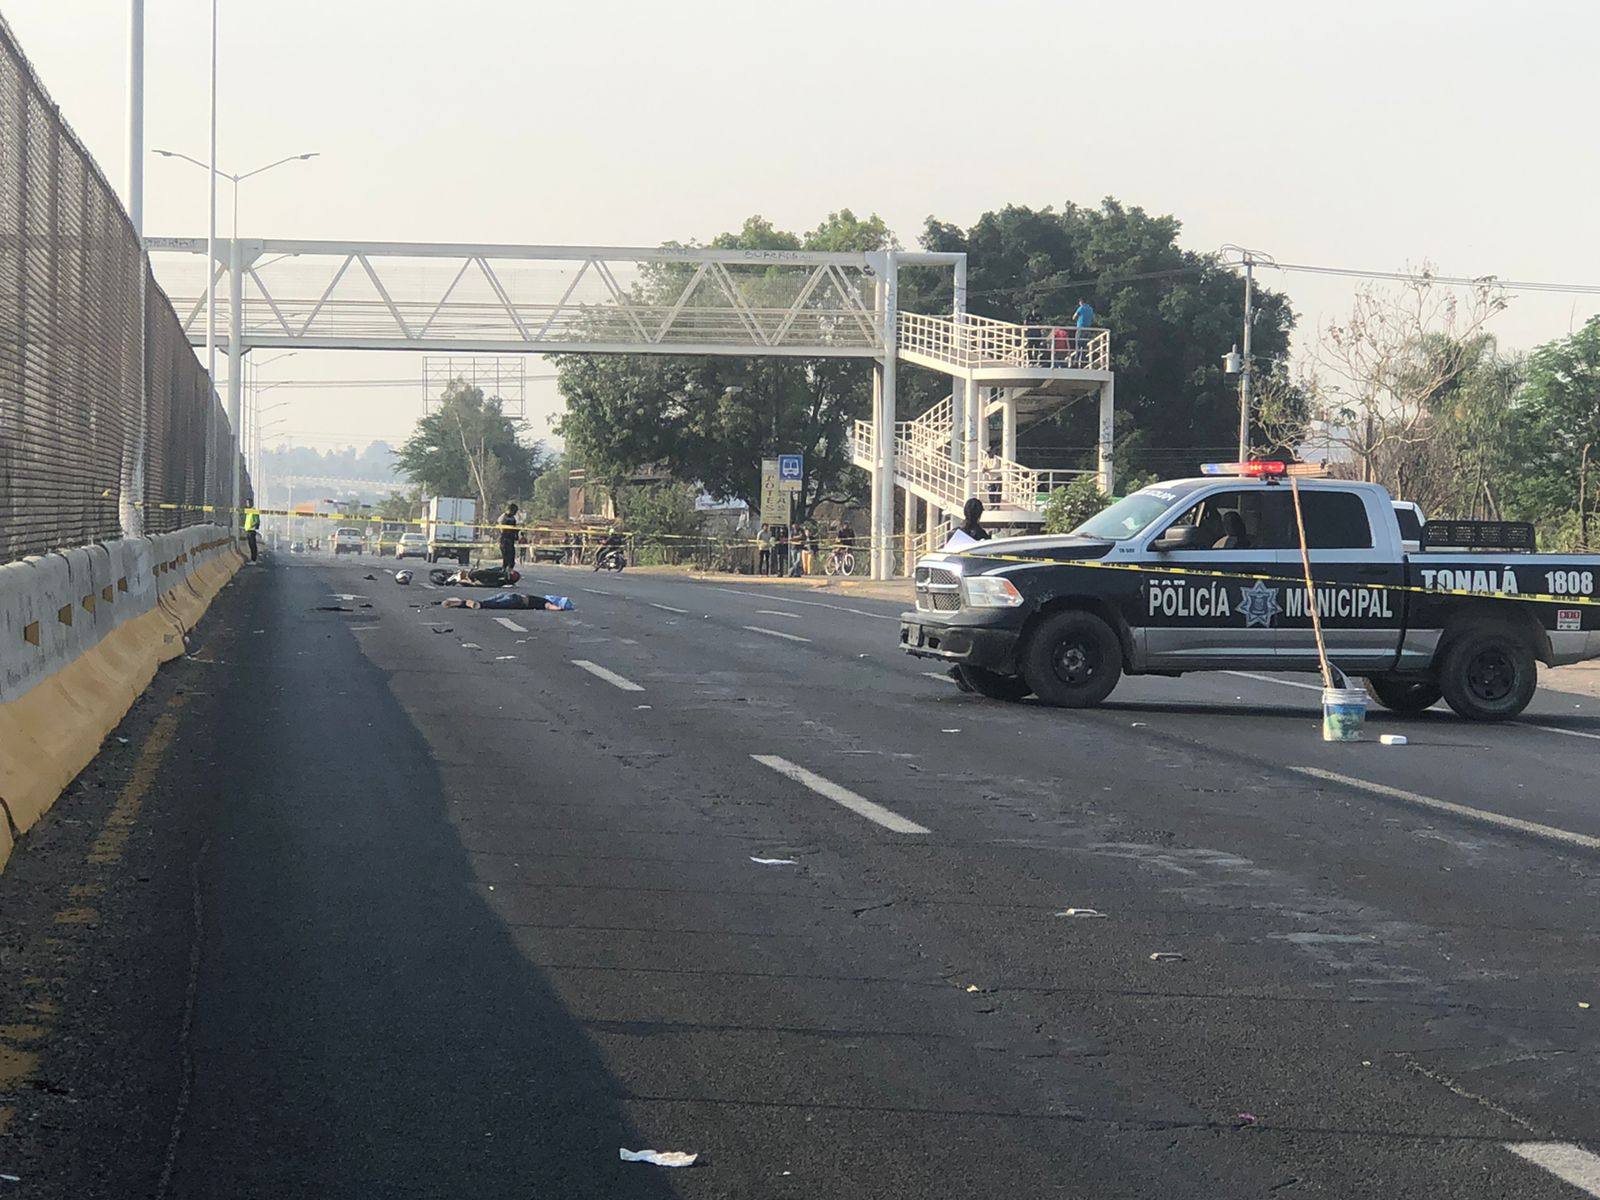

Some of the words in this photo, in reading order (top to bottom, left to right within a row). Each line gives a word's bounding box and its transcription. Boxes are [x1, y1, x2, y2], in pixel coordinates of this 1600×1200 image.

[1421, 566, 1519, 595] TONALÁ
[1544, 571, 1593, 595] 1808
[1149, 581, 1230, 617] POLICÍA
[1286, 588, 1393, 618] MUNICIPAL
